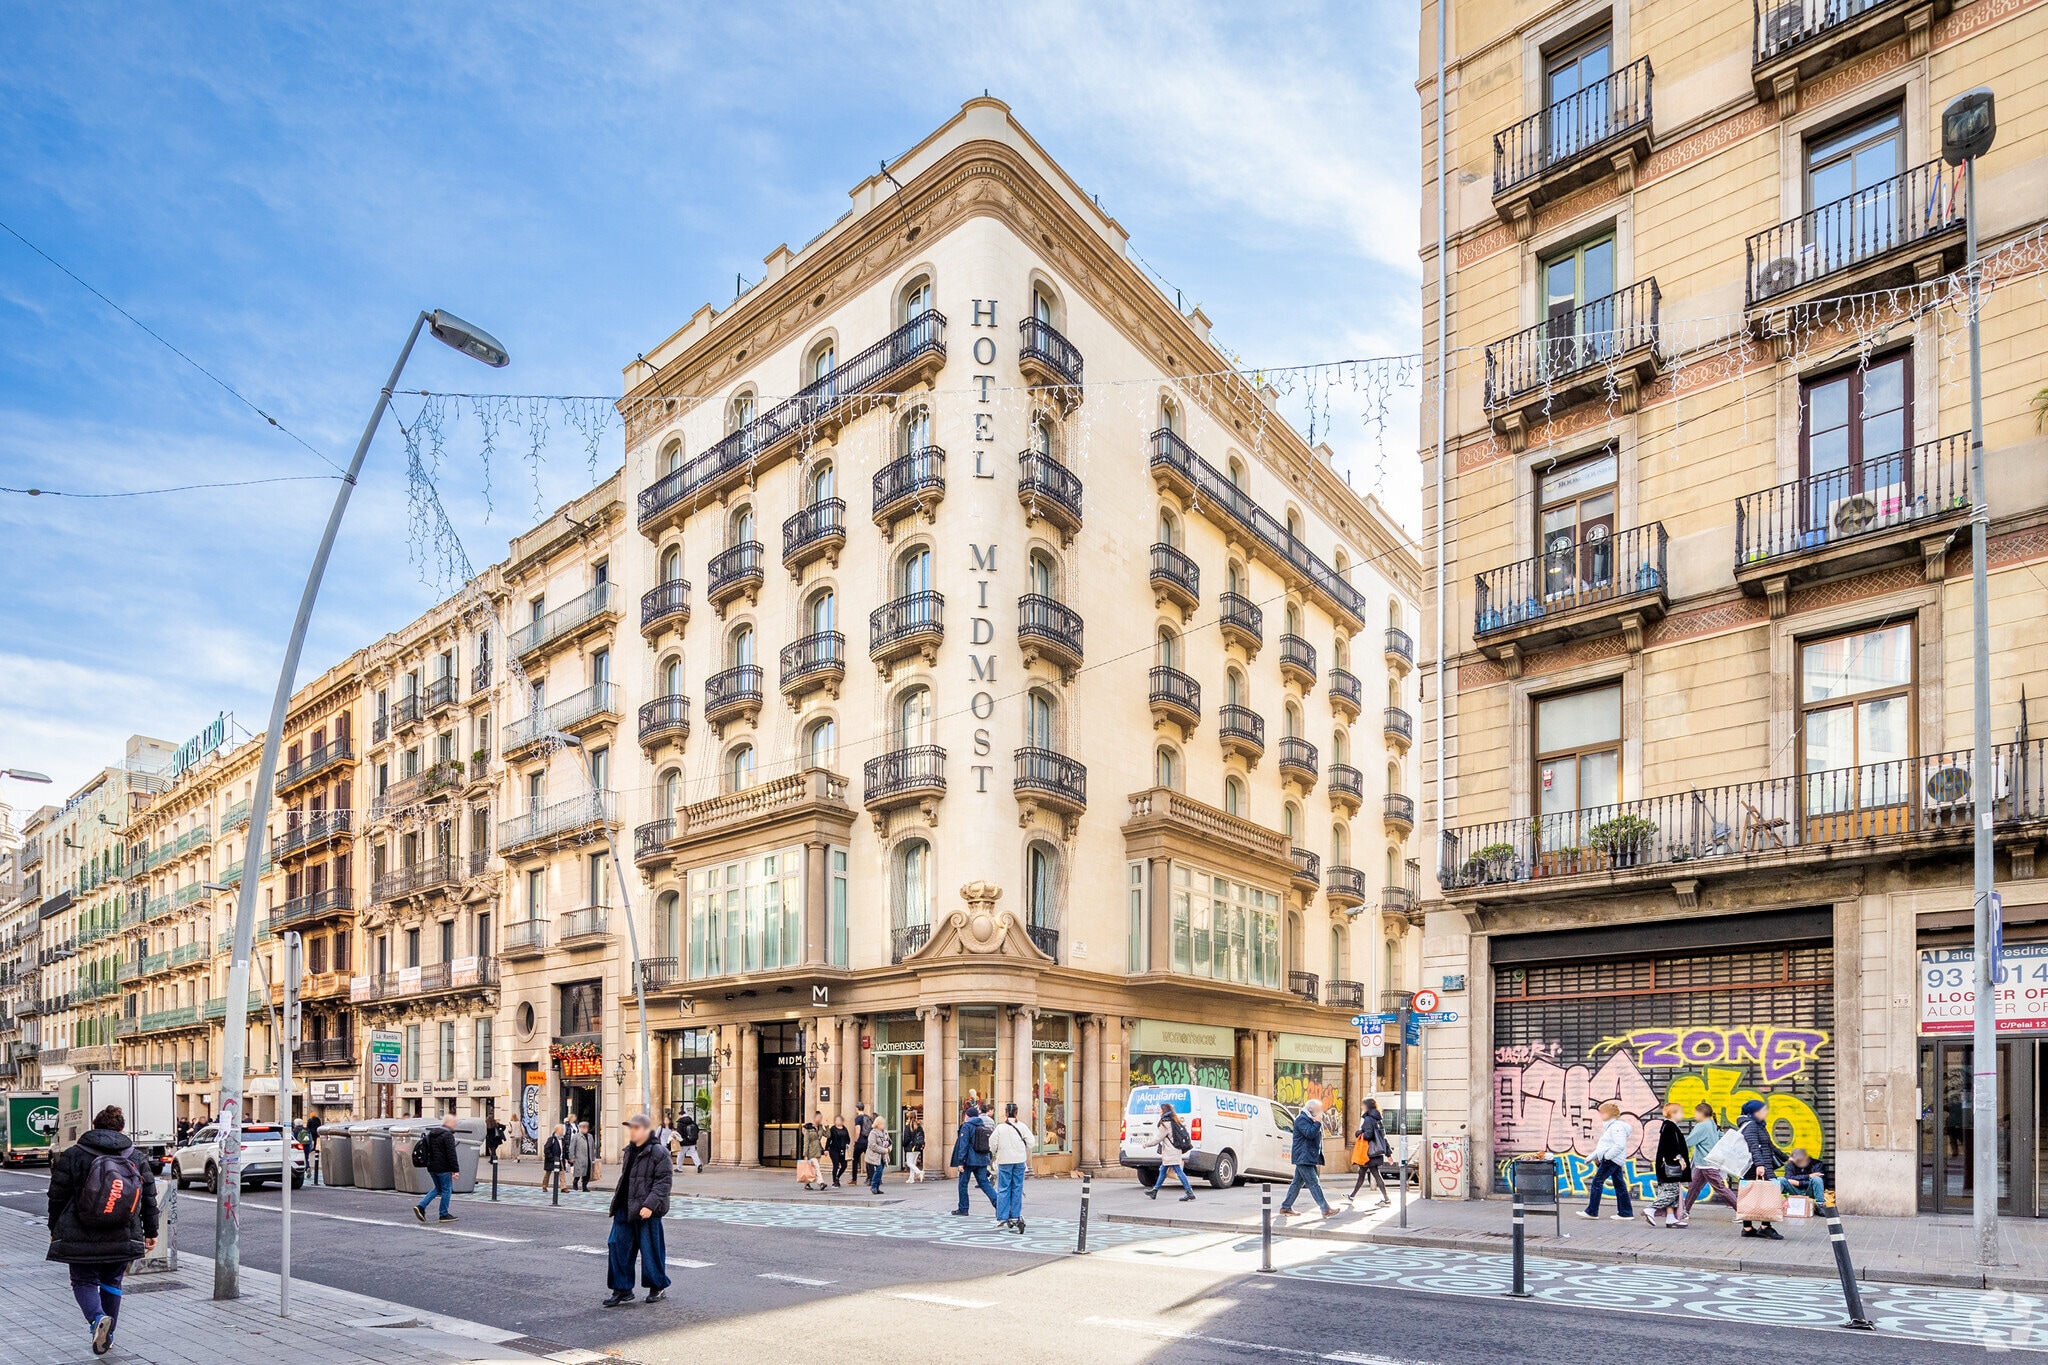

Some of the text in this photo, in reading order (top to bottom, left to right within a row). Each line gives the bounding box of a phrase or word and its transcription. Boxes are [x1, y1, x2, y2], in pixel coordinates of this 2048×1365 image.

[968, 298, 998, 793] HOTEL MIDMOST
[172, 734, 200, 778] HOTEL
[1927, 968, 1964, 988] 93
[1420, 998, 1426, 1006] 6
[1927, 989, 2015, 1004] LLOGER
[1927, 1002, 2016, 1017] ALQUER
[1215, 1095, 1259, 1119] telefurgo
[104, 1178, 124, 1214] Wilson
